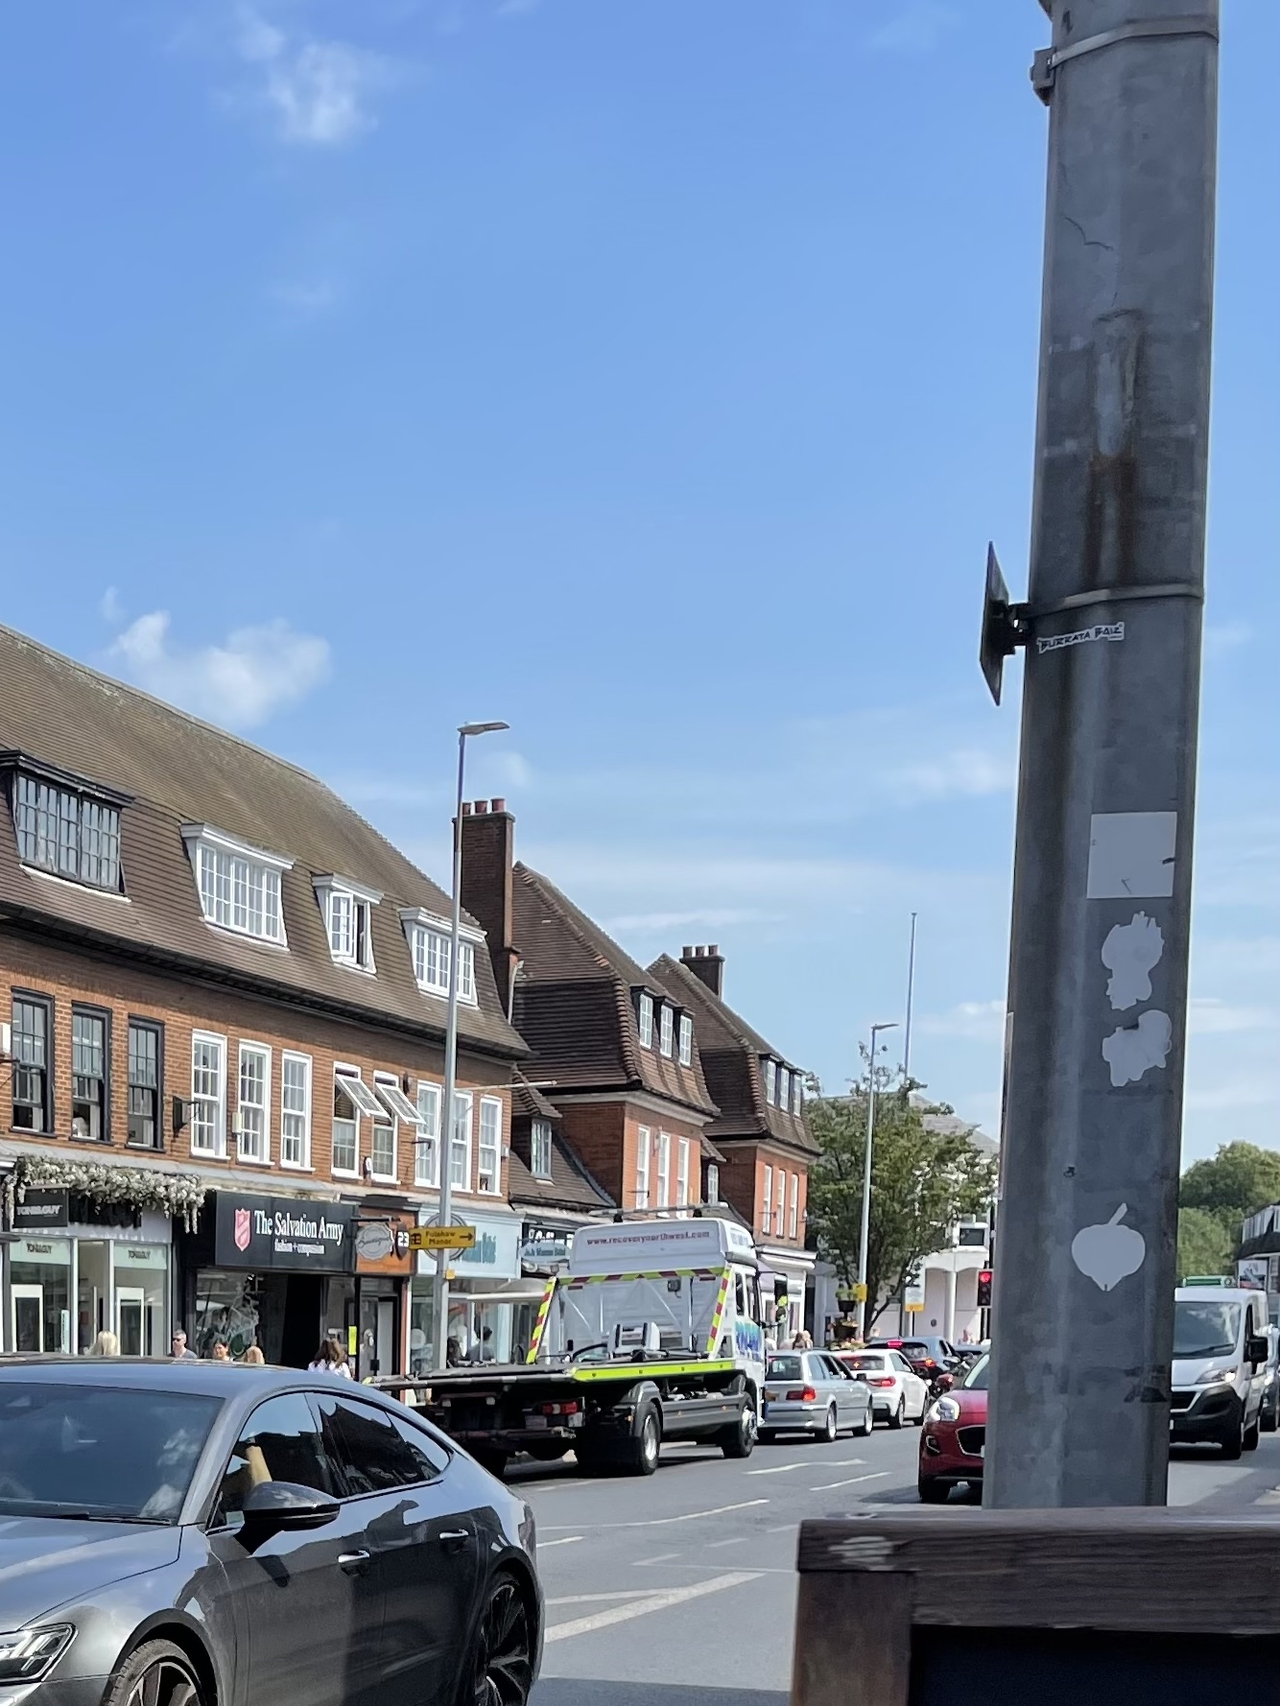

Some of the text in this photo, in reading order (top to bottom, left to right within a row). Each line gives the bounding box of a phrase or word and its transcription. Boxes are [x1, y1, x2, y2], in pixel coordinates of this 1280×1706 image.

[254, 1210, 274, 1236] The
[275, 1211, 317, 1239] Salvation
[319, 1216, 344, 1246] Army
